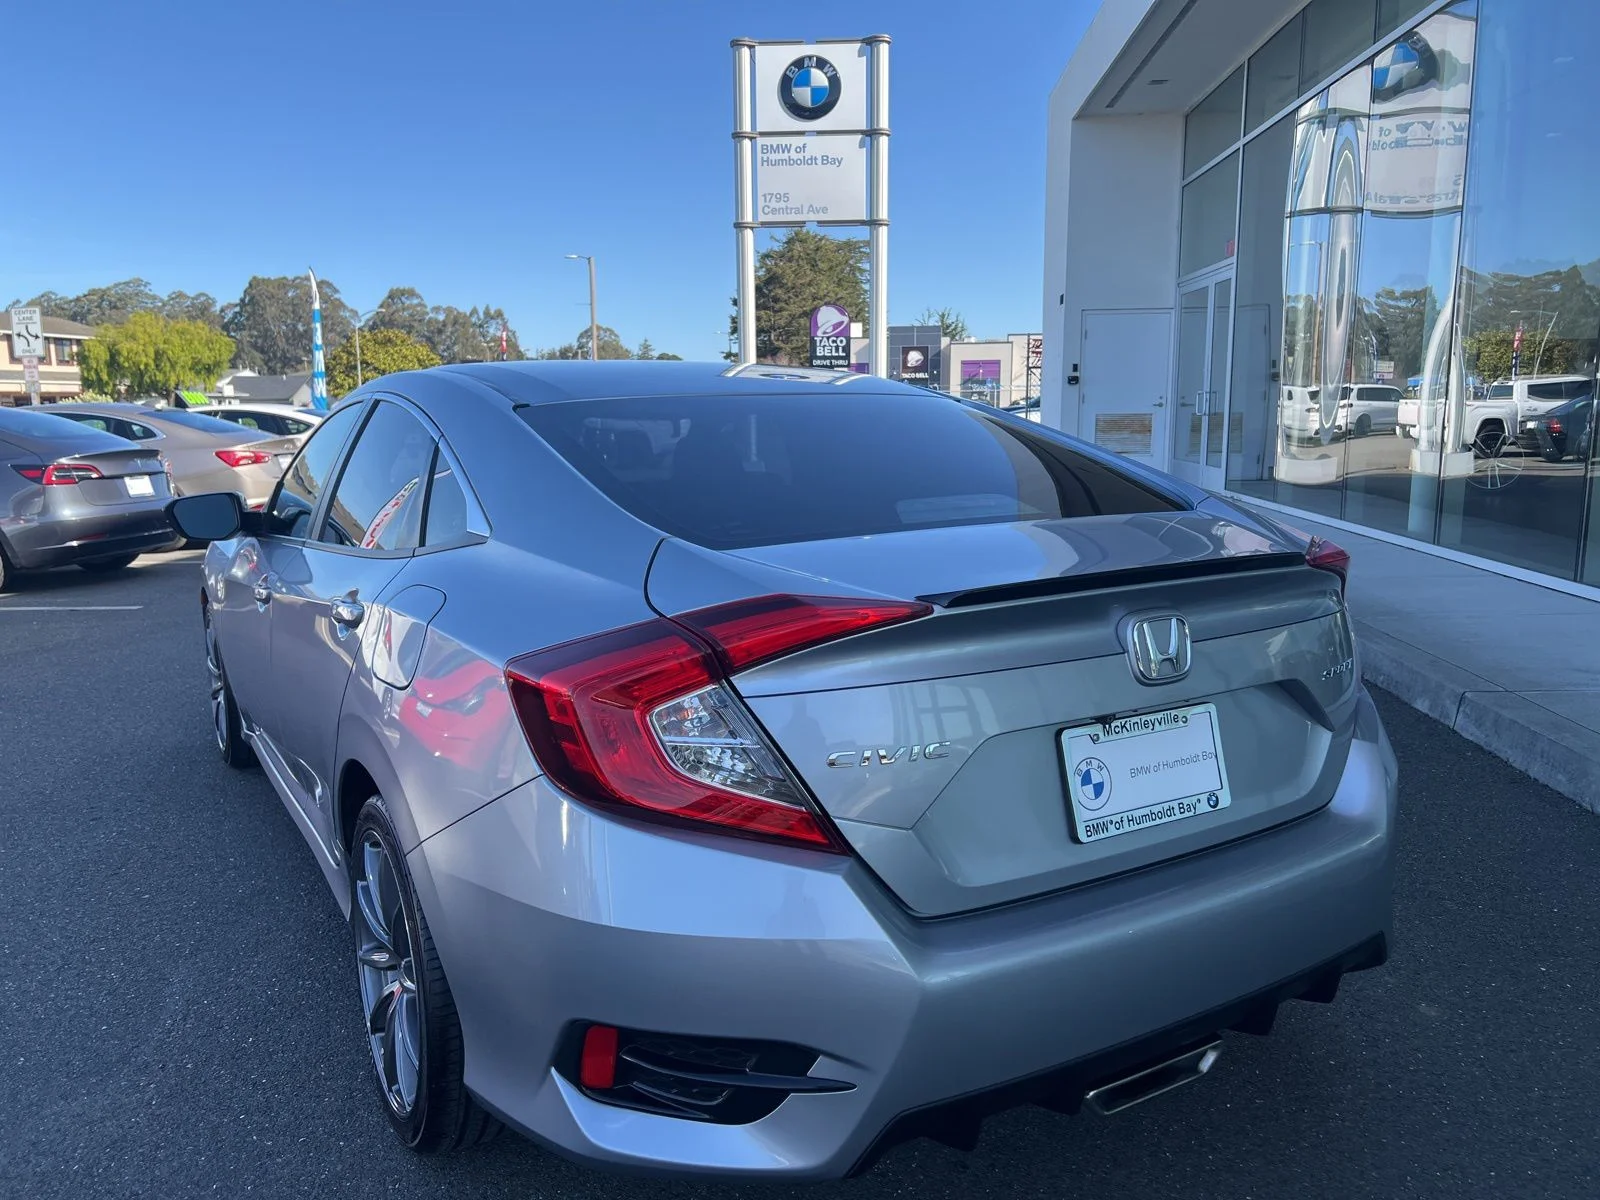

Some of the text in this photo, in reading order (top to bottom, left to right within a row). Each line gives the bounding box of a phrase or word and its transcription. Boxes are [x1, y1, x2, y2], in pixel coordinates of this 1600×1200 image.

[785, 56, 837, 79] BMW
[761, 143, 807, 155] BMW of
[761, 155, 843, 168] Humboldt Bay
[761, 192, 790, 204] 1795
[762, 204, 829, 216] Central Ave
[814, 336, 847, 347] TACO
[816, 346, 846, 356] BELL
[1103, 712, 1179, 737] McKinleyville
[826, 741, 951, 769] CIVIC
[1076, 759, 1105, 778] BMW
[1129, 763, 1151, 779] BMW
[1153, 761, 1162, 773] of
[1162, 754, 1201, 770] Humboldt
[1114, 816, 1125, 831] of
[1127, 805, 1176, 828] Humboldt
